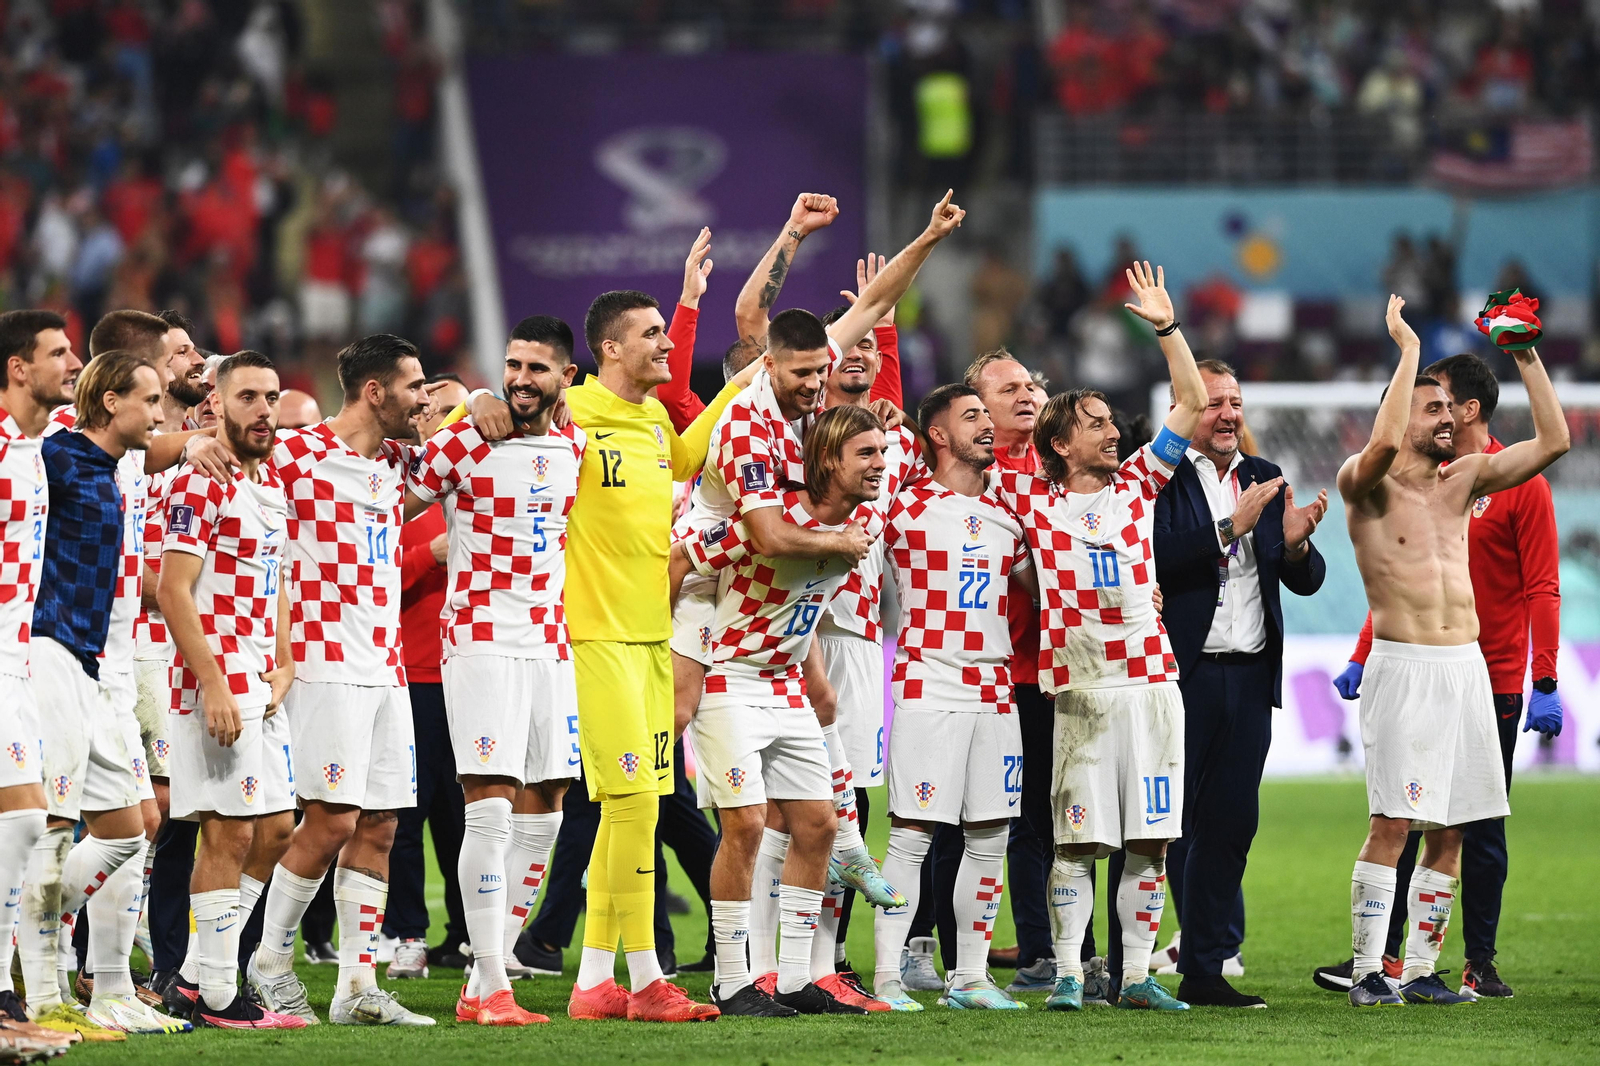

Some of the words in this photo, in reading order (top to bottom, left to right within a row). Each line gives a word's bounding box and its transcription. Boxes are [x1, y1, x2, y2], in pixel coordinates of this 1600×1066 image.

[598, 449, 626, 488] 12
[366, 526, 389, 564] 14
[533, 517, 547, 552] 5
[261, 559, 278, 595] 13
[1089, 551, 1121, 588] 10
[958, 571, 991, 609] 22
[783, 604, 820, 637] 19
[567, 715, 580, 753] 5
[654, 730, 669, 770] 12
[1003, 755, 1024, 793] 22
[842, 789, 854, 798] HN
[1143, 776, 1171, 814] 10
